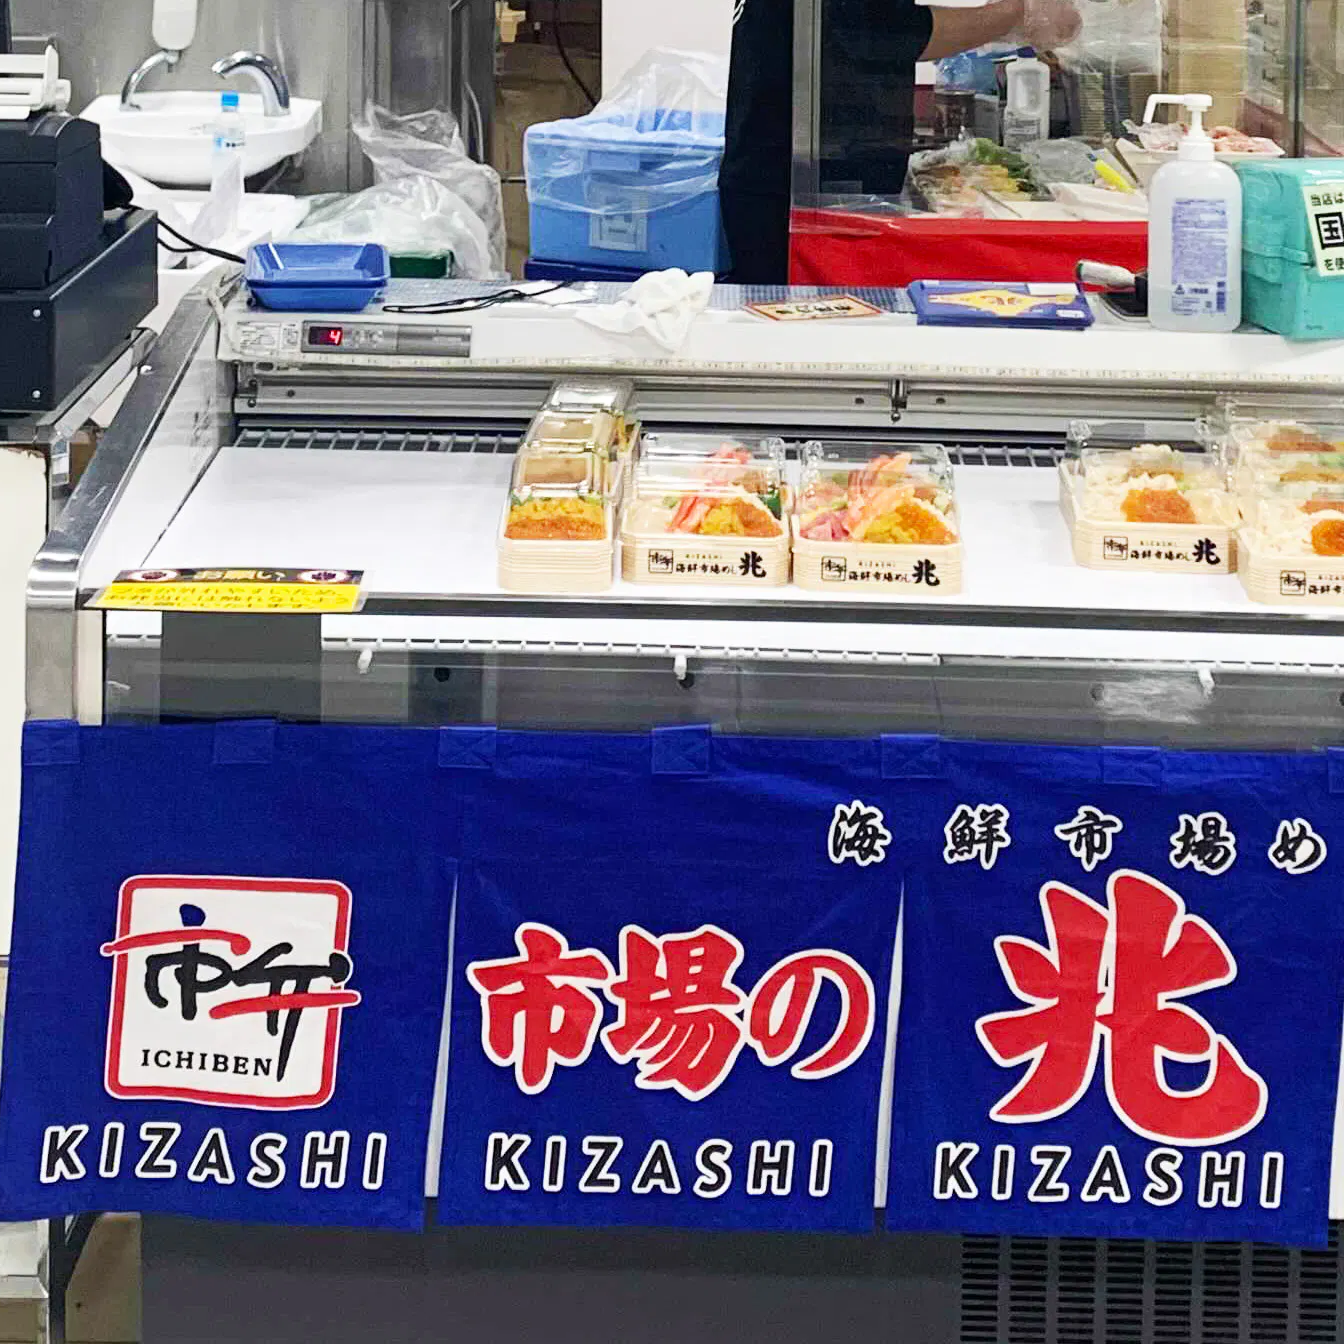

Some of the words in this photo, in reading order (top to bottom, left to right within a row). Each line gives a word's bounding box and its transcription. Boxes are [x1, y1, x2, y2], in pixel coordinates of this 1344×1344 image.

[1310, 191, 1344, 208] 当店は
[328, 329, 343, 346] 4
[739, 550, 767, 579] 兆
[1193, 537, 1221, 566] 兆
[913, 559, 941, 588] 兆
[466, 922, 875, 1101] 市場の
[975, 867, 1268, 1148] 兆
[141, 1049, 273, 1077] ICHIBEN
[39, 1121, 388, 1190] KIZASHI
[485, 1133, 833, 1199] KIZASHI
[932, 1142, 1286, 1209] KIZASHI
